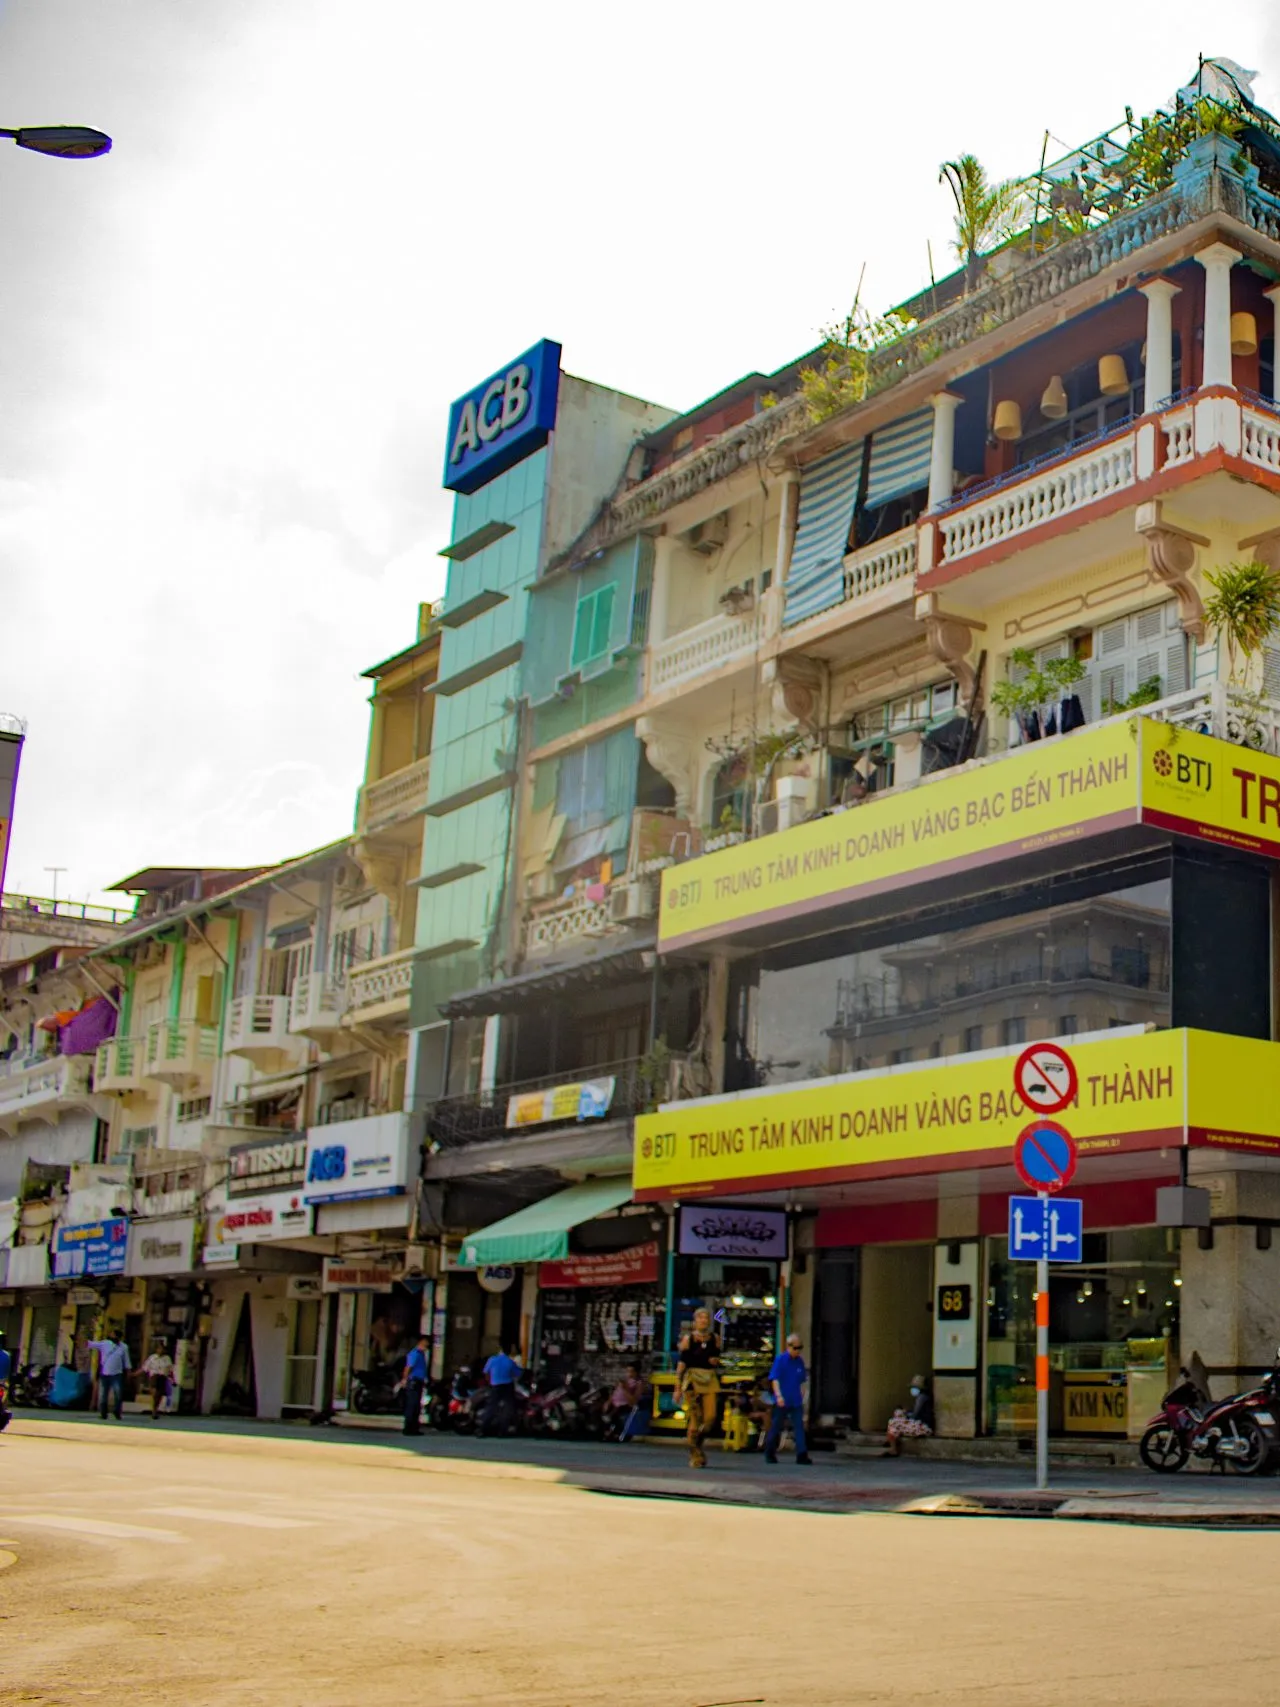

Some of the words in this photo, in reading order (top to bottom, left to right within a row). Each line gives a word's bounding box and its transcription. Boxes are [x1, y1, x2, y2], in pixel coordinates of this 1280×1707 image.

[450, 363, 532, 465] ACB
[1176, 753, 1212, 792] BTJ
[713, 866, 763, 900] TRUNG
[767, 853, 799, 884] TÂM
[803, 838, 841, 872] KINH
[845, 825, 906, 861] DOANH
[911, 802, 962, 843] VÀNG
[965, 791, 1006, 828] BẠC
[1010, 769, 1052, 813] BẾN
[1057, 752, 1129, 800] THÀNH
[688, 1127, 745, 1159] TRUNG
[749, 1117, 786, 1152] TÂM
[790, 1116, 834, 1146] KINH
[840, 1104, 908, 1140] DOANH
[915, 1089, 972, 1127] VÀNG
[979, 1088, 1025, 1126] BẠC
[1087, 1062, 1173, 1108] THÀNH
[248, 1139, 306, 1174] TISSOT
[653, 1132, 677, 1159] BTJ
[307, 1146, 347, 1183] ACB
[484, 1265, 512, 1280] ACB
[942, 1290, 963, 1312] 68
[1069, 1390, 1099, 1418] KIM
